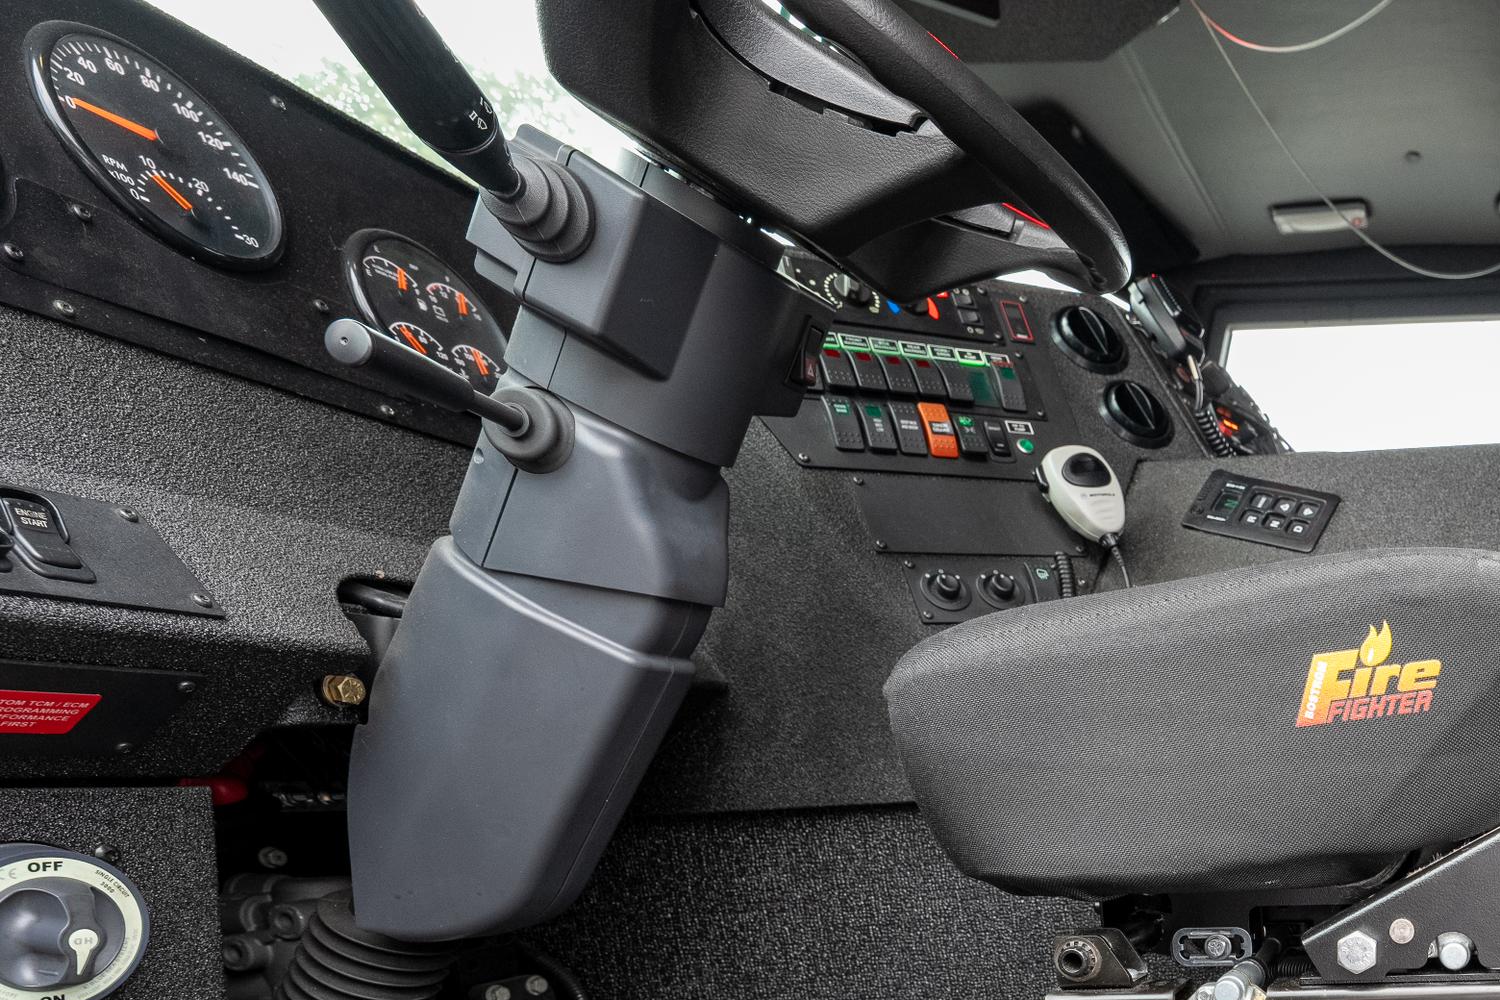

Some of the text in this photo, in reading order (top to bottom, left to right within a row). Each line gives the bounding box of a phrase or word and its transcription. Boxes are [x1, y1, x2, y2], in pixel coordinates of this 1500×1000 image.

[77, 56, 98, 74] 40
[104, 57, 125, 75] 60
[63, 67, 85, 86] 20
[140, 74, 160, 92] 80
[172, 102, 200, 123] 100
[197, 131, 225, 150] 120
[101, 154, 128, 172] RPM
[138, 155, 156, 169] 10
[191, 177, 209, 192] 20
[223, 168, 248, 186] 140
[130, 188, 140, 200] 0
[242, 234, 259, 248] 30
[14, 507, 48, 521] ENGINE
[20, 516, 48, 529] START
[1296, 620, 1442, 728] Fire
[29, 700, 57, 708] TCM
[1326, 689, 1434, 725] FIGHTER
[27, 861, 64, 873] OFF
[95, 869, 130, 898] SINGLE CIRCUIT
